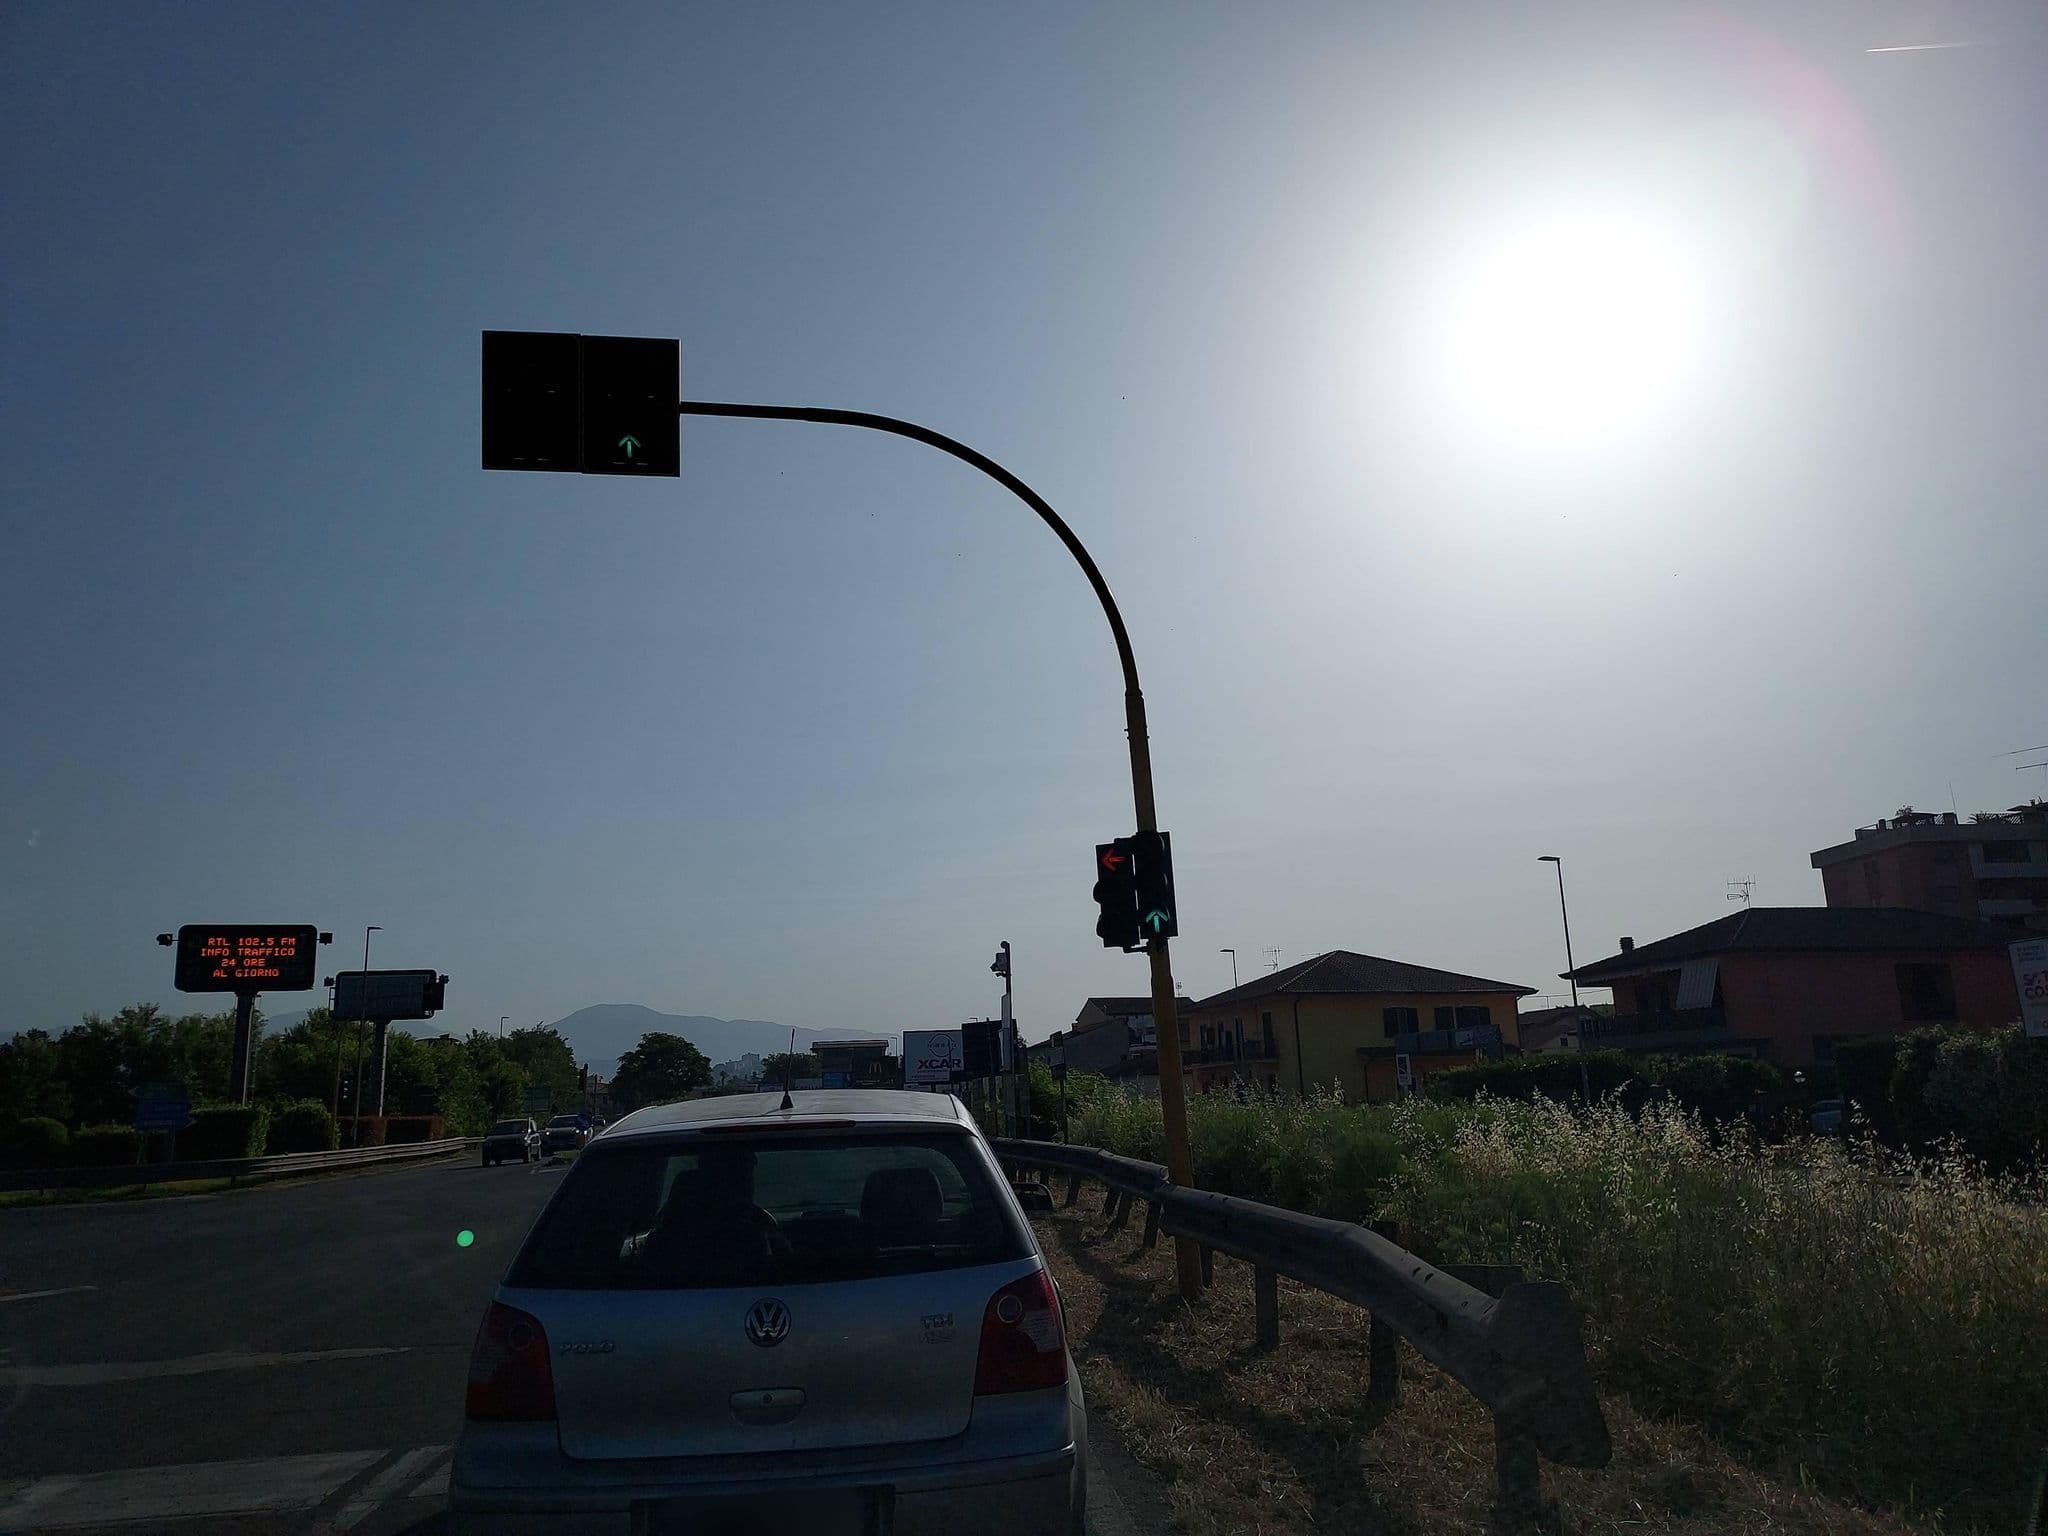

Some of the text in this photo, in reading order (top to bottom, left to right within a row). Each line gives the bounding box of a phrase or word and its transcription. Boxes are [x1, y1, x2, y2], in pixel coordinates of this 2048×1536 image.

[208, 937, 296, 946] RTL 102.5 FM
[200, 948, 296, 957] INFO TRAFFICO
[221, 958, 266, 967] 24 ORE
[212, 968, 280, 977] AL GIORNO
[917, 1058, 962, 1070] XCAR
